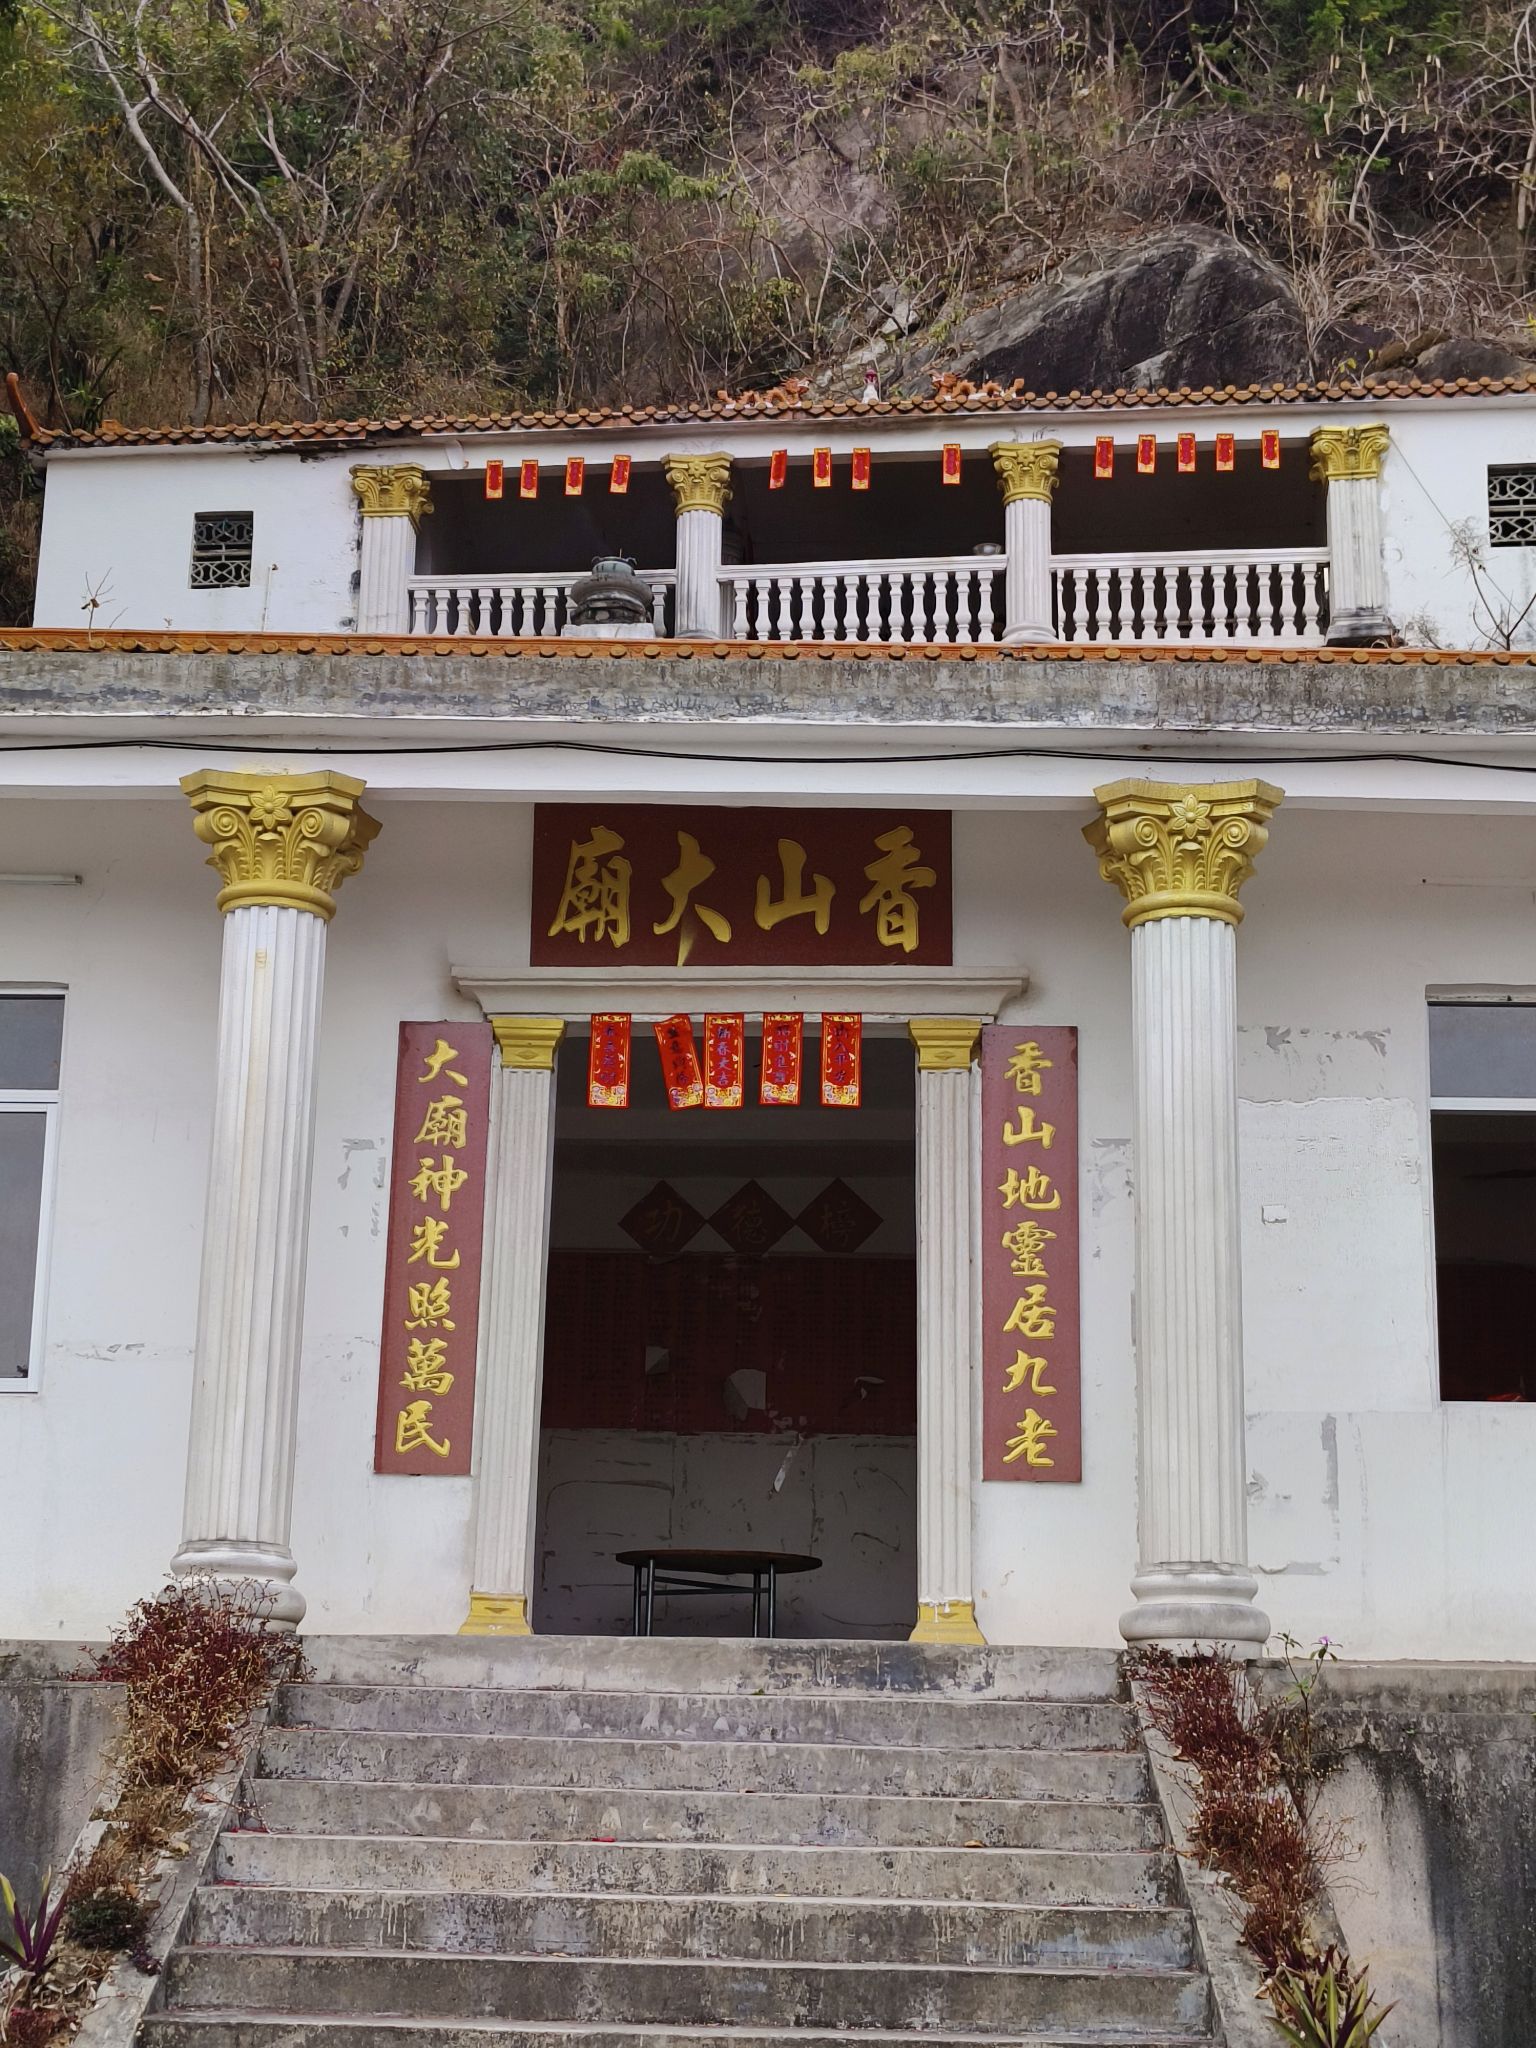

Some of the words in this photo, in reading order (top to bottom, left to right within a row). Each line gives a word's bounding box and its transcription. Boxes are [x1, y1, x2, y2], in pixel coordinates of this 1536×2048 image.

[547, 825, 938, 954] 香山大廟
[395, 1039, 469, 1458] 大廟神光照萬民
[643, 1199, 857, 1248] 功德榜
[997, 1040, 1062, 1468] 香山地靈居九老
